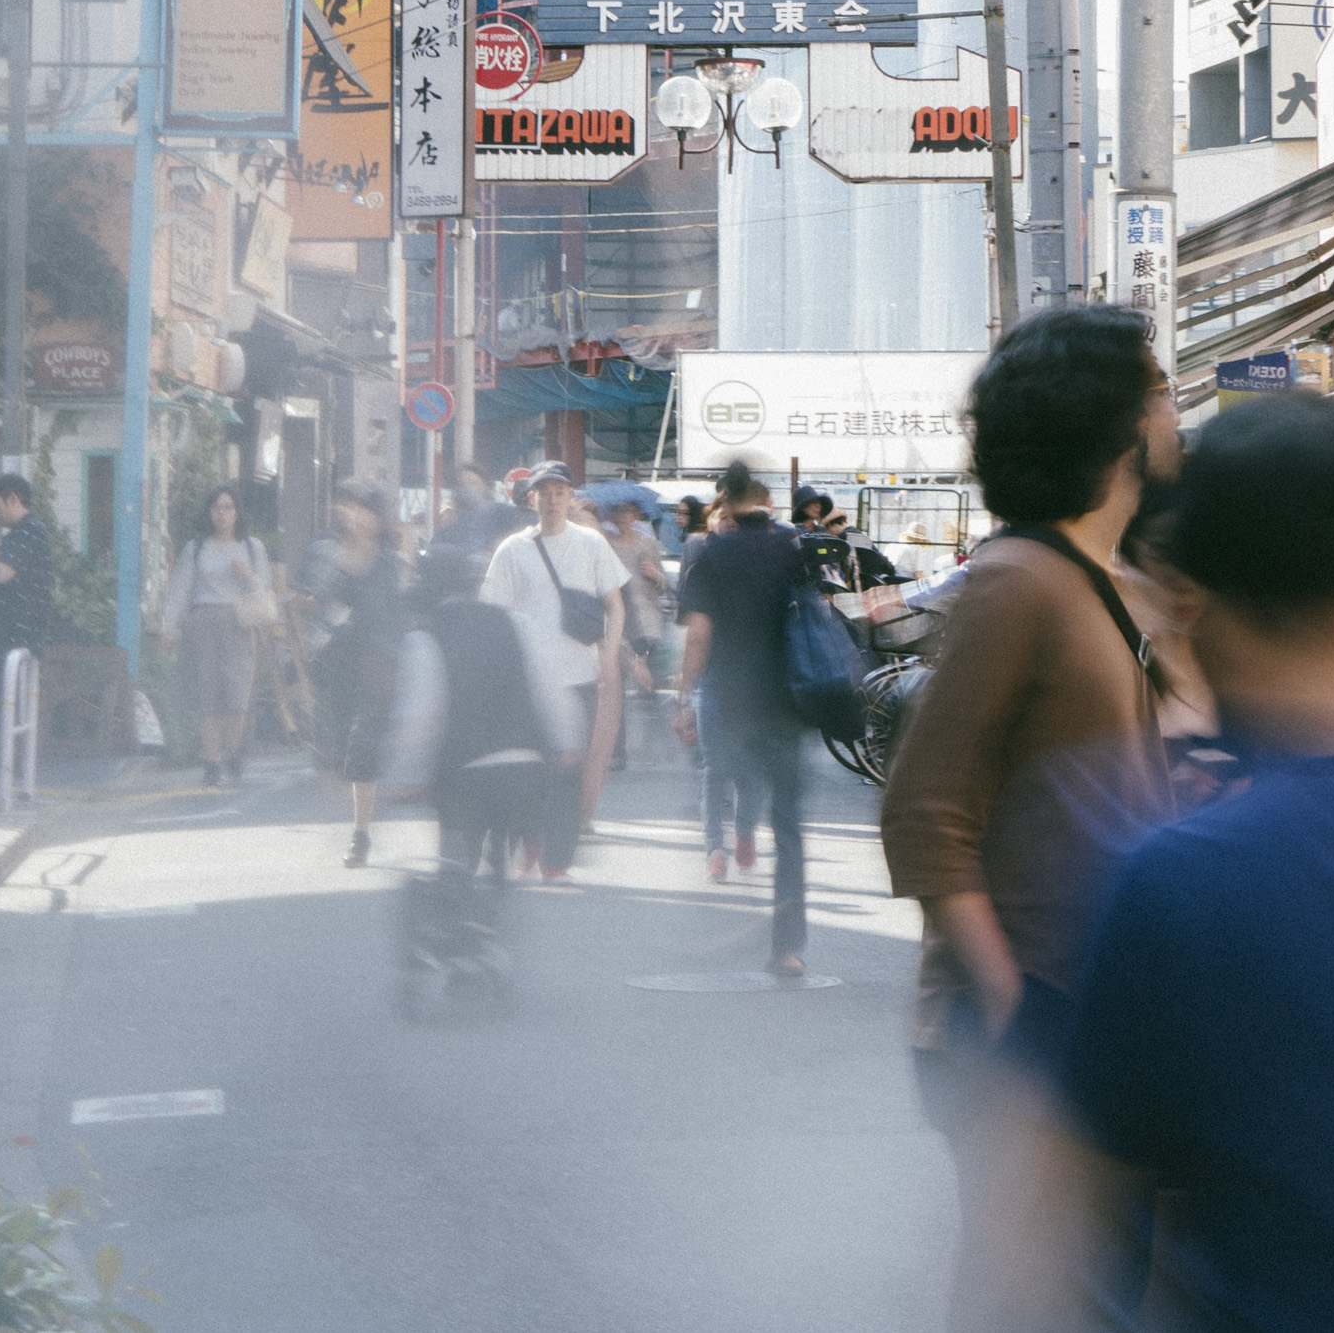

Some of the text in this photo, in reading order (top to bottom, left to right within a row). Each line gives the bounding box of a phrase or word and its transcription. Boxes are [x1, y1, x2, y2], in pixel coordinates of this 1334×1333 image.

[586, 0, 871, 35] 下北沢東会
[490, 33, 518, 43] HYDRANT
[1127, 207, 1144, 245] 教授
[51, 367, 102, 379] PLACE
